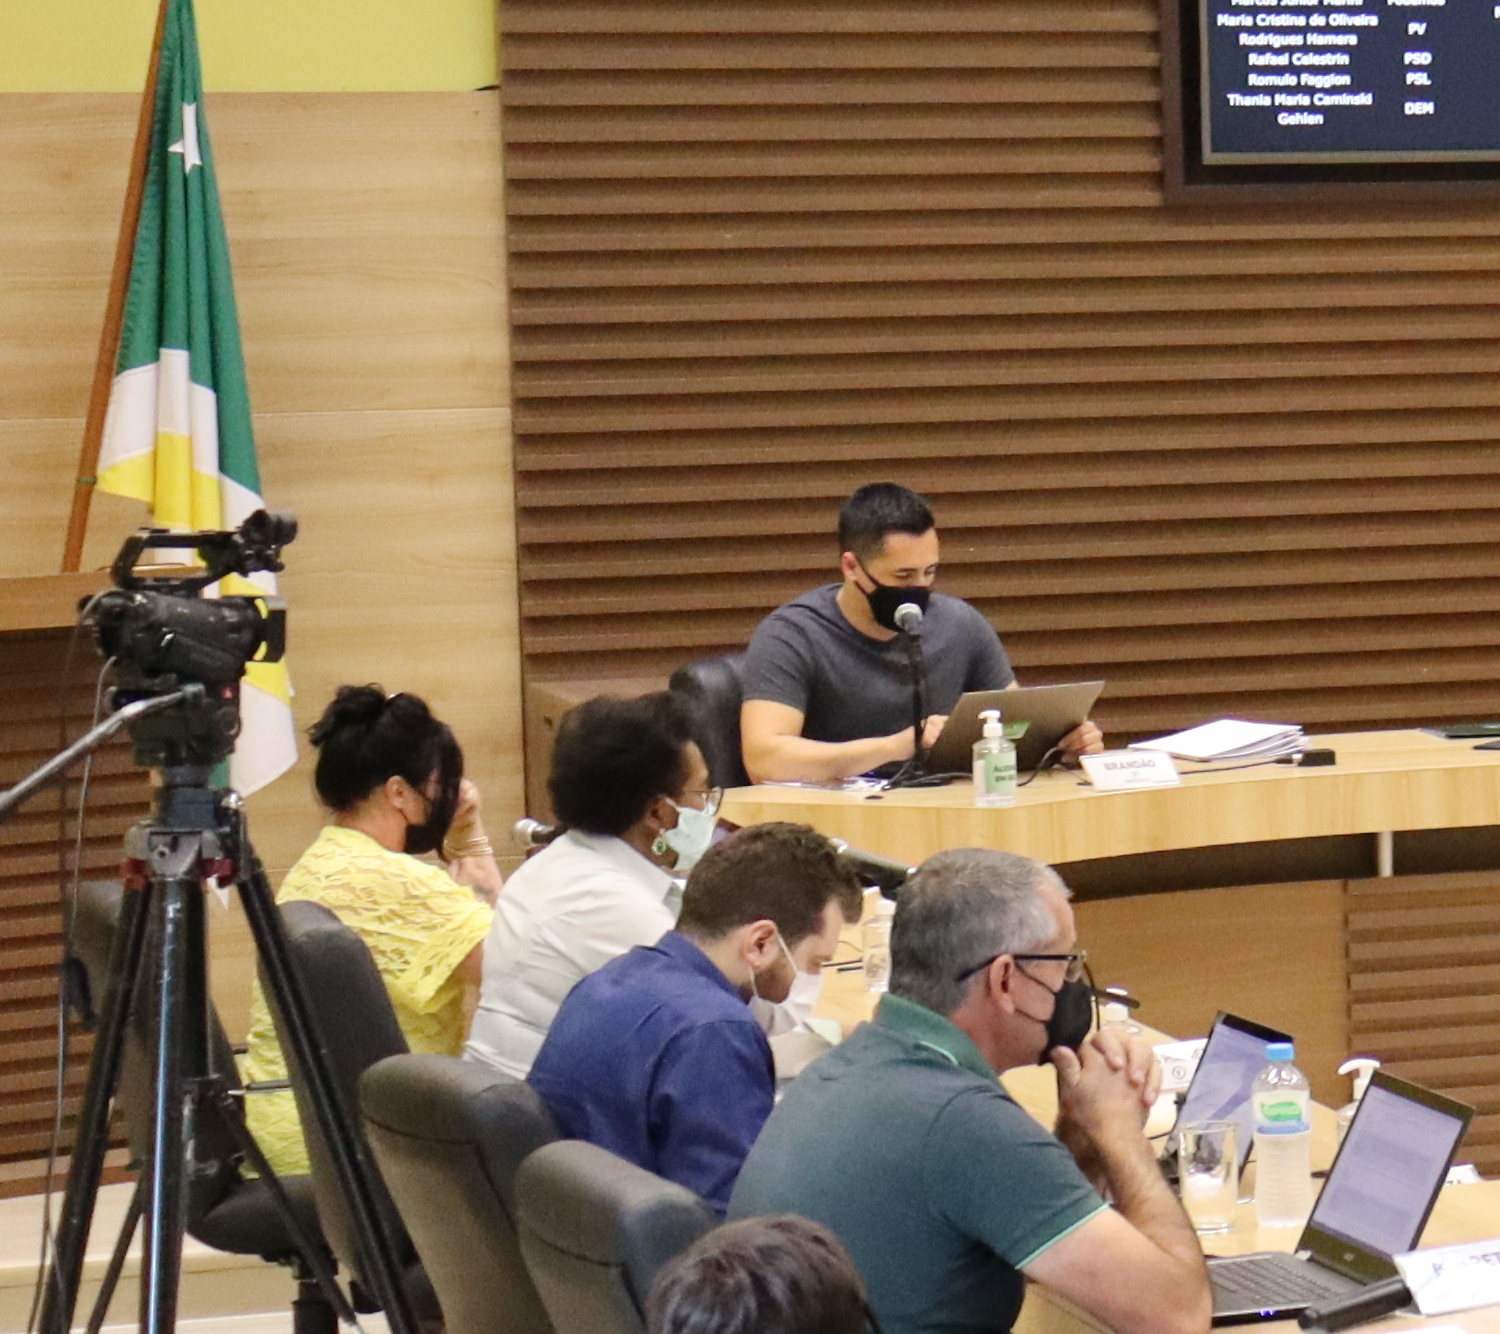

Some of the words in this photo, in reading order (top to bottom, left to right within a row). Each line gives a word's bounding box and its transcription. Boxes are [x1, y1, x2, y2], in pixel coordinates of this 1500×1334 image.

[1217, 12, 1254, 26] Maria
[1255, 12, 1307, 26] Cristina
[1308, 12, 1327, 26] de
[1328, 11, 1379, 26] Oliveira
[1408, 21, 1427, 35] PV
[1239, 31, 1304, 48] Rodrigues
[1248, 51, 1290, 65] Rafael
[1291, 51, 1350, 65] Celestrin
[1404, 50, 1432, 65] PSD
[1248, 72, 1298, 86] Romulo
[1300, 71, 1351, 88] Faggion
[1406, 70, 1432, 85] PSL
[1227, 92, 1272, 106] Thania
[1274, 92, 1311, 106] Maria
[1313, 92, 1373, 106] Caminski
[1405, 100, 1434, 115] DEM
[1277, 111, 1324, 125] Gehlen
[1103, 758, 1157, 771] BRANDÃO
